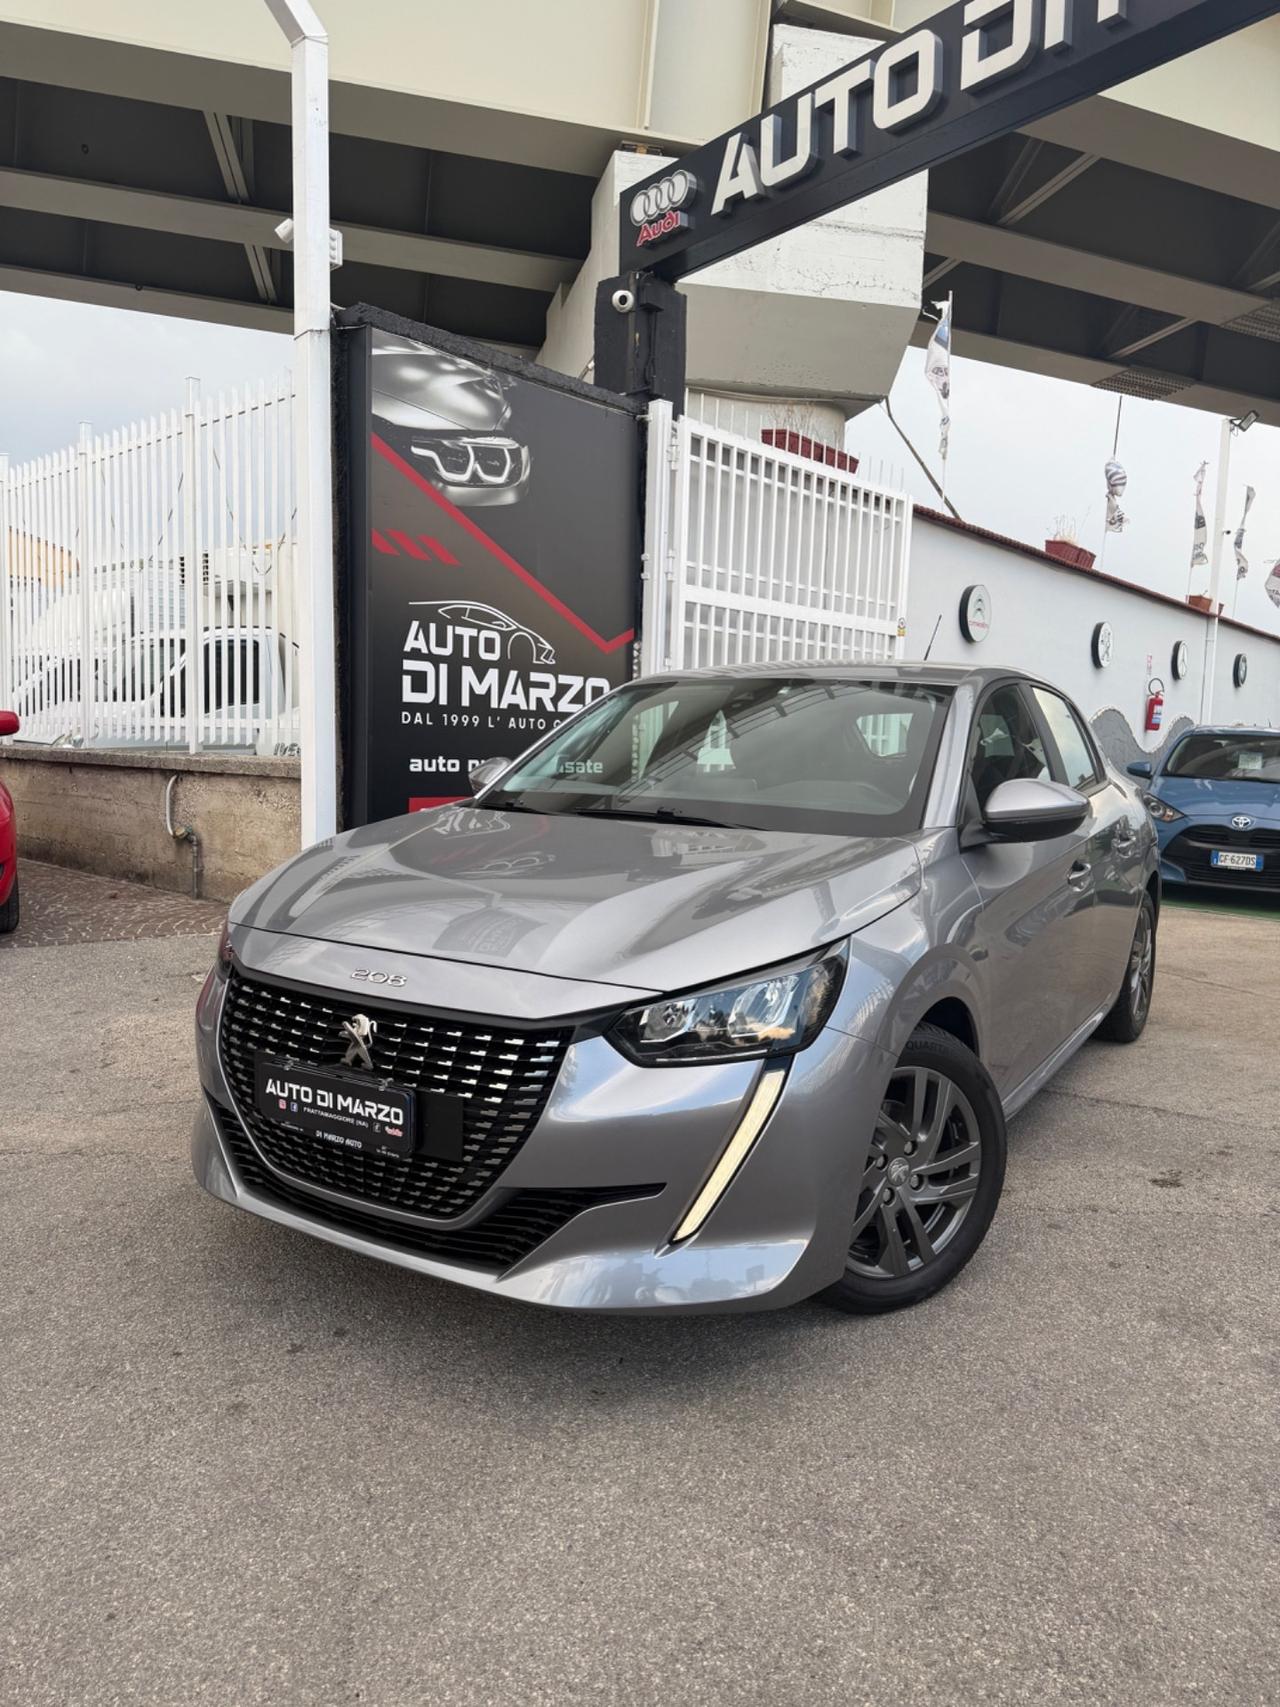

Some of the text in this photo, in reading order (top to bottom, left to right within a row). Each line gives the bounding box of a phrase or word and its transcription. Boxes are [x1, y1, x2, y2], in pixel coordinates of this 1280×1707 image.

[711, 29, 936, 215] AUTO
[635, 210, 681, 247] Audi
[403, 620, 501, 661] AUTO
[402, 659, 610, 713] DI MARZO
[401, 711, 434, 726] DAL
[442, 713, 480, 728] 1999
[488, 716, 501, 728] L'
[508, 717, 546, 730] AUTO
[409, 756, 460, 772] auto
[350, 968, 407, 988] 208
[265, 1078, 404, 1126] AUTO DI MARZO
[322, 1131, 345, 1142] MARZO
[344, 1138, 363, 1149] AUTO
